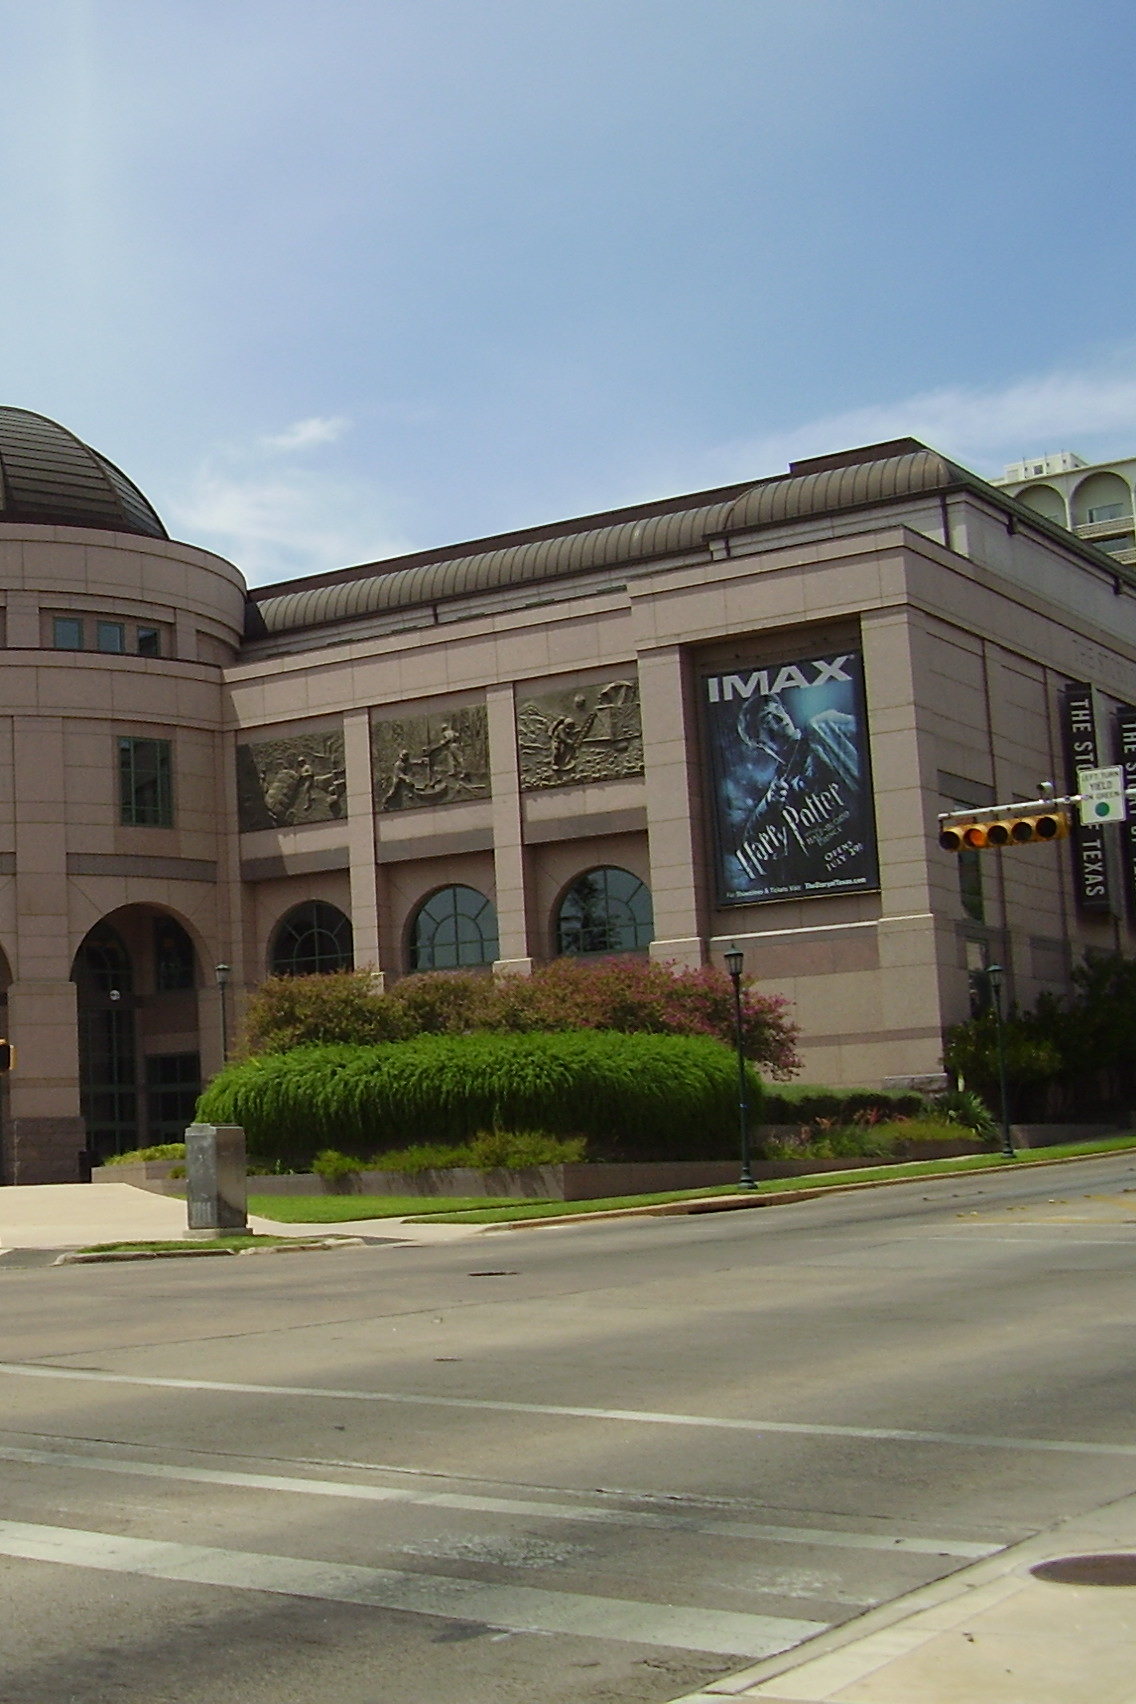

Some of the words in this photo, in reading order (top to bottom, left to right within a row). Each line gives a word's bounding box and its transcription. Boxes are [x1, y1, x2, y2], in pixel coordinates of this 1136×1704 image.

[707, 655, 853, 702] IMAX
[1070, 699, 1091, 733] THE
[1082, 839, 1105, 897] TEXAS
[1089, 780, 1113, 791] YIELD
[736, 825, 788, 879] Harry
[782, 783, 844, 857] Potter
